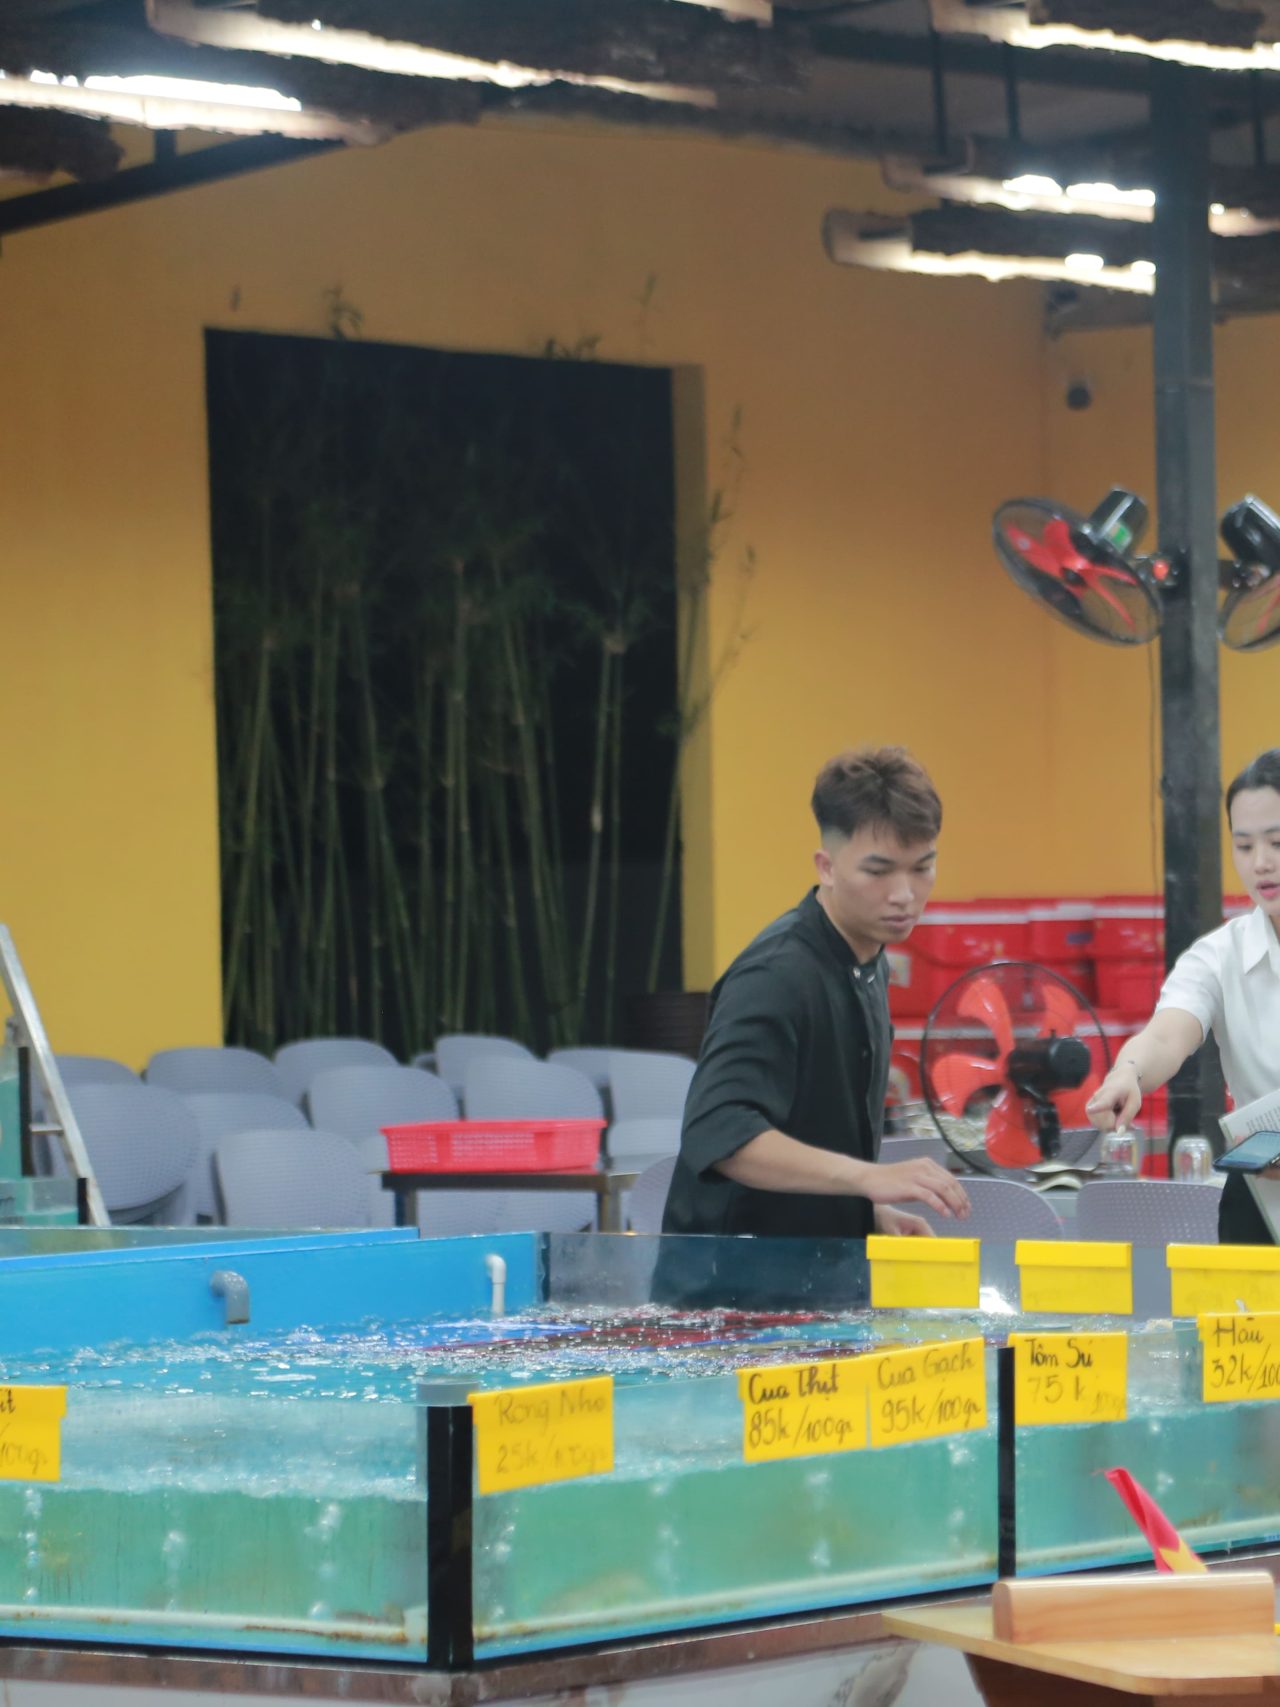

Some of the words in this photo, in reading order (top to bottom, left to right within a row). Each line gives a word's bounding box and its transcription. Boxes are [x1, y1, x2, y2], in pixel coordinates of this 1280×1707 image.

[1024, 1338, 1059, 1367] Tôm
[749, 1373, 789, 1405] Cua
[877, 1357, 916, 1390] Cua
